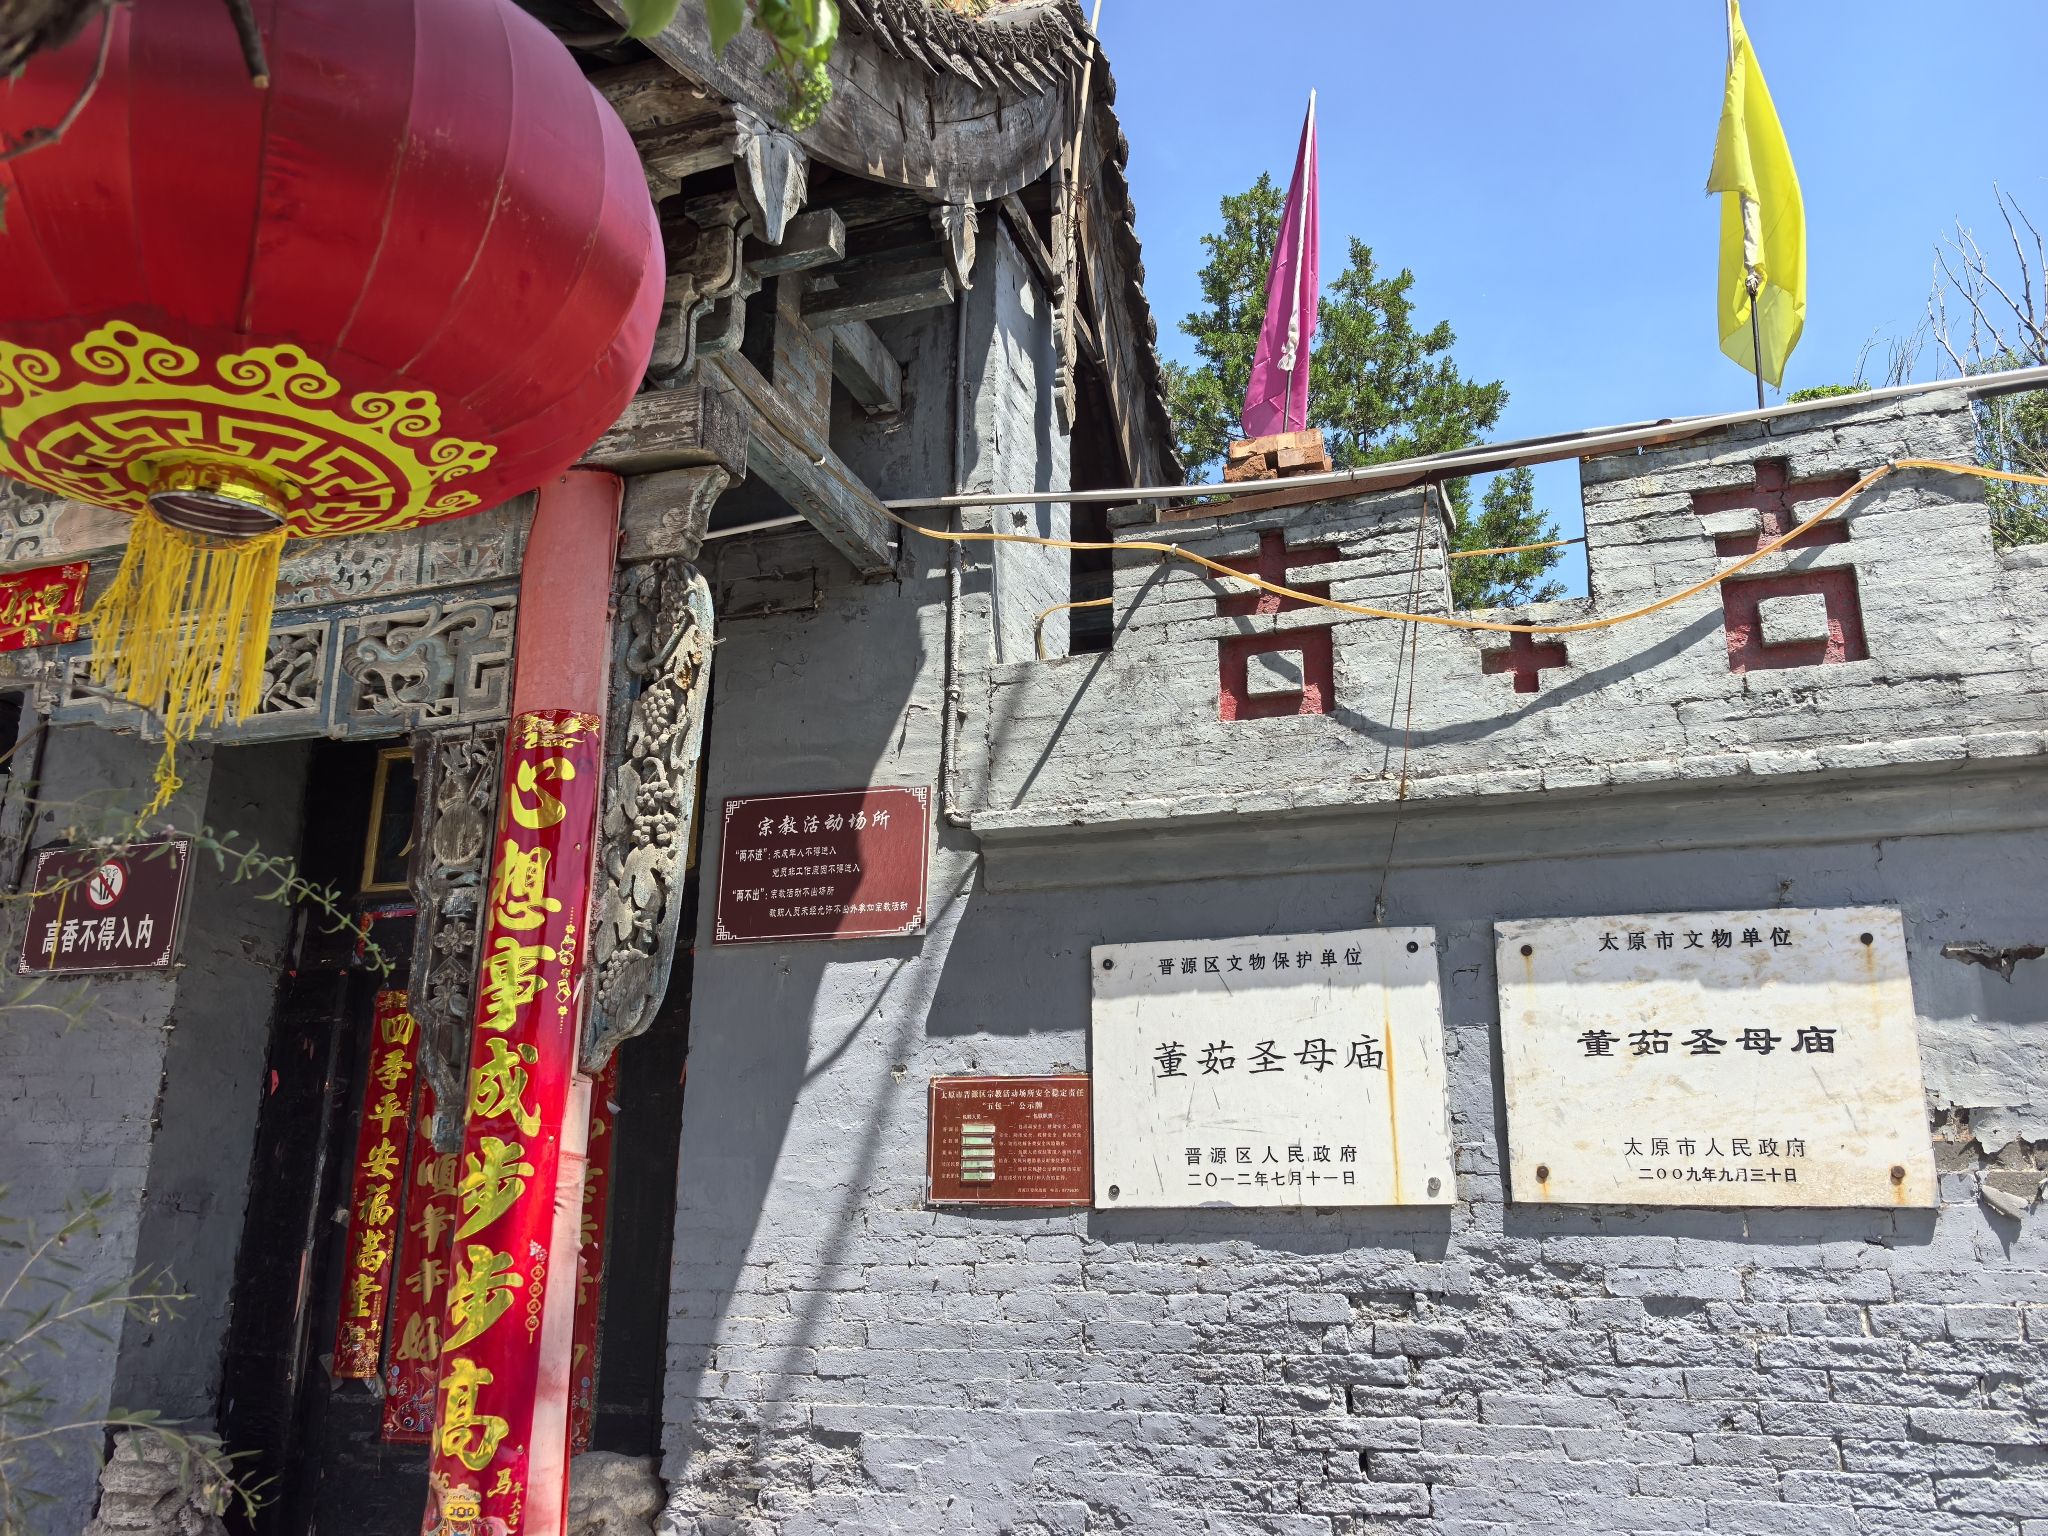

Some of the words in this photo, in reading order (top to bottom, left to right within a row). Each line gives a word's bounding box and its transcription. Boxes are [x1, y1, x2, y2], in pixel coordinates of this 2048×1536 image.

[758, 809, 891, 837] 宗教活动场所
[772, 863, 861, 878] 党员非工作原因不得进入
[41, 913, 154, 955] 高香不得入内
[1598, 926, 1794, 952] 太原市文物单位
[1157, 947, 1364, 976] 晋源区文物保护单位
[1576, 1025, 1838, 1058] 董茹圣母庙
[1153, 1033, 1385, 1079] 董茹圣母庙
[433, 757, 577, 1471] 心想事成步步高
[1184, 1144, 1358, 1165] 晋源区人民政府
[1623, 1136, 1807, 1158] 太原市人民政府
